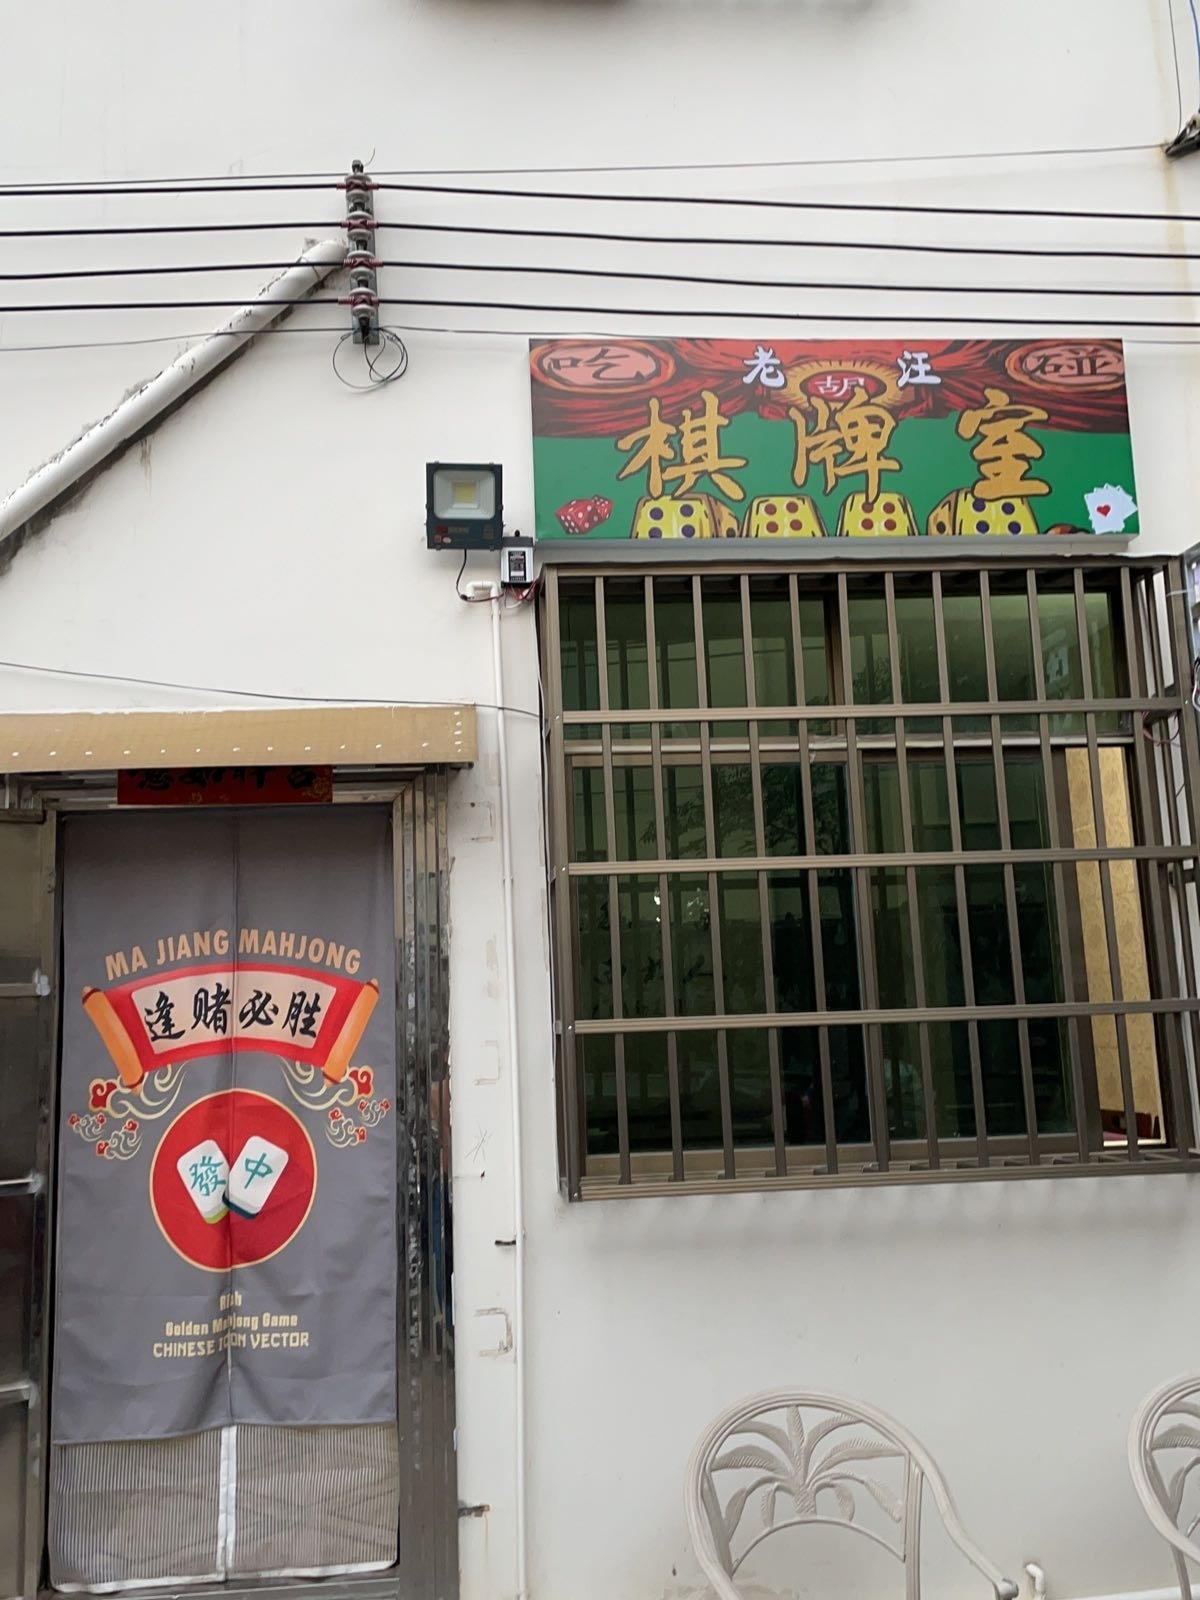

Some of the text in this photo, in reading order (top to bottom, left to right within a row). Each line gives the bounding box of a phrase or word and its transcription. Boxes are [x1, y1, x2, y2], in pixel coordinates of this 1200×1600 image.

[549, 347, 645, 382] 吃
[615, 388, 1052, 504] 棋牌室
[104, 928, 361, 981] MA JIANG MAHJONG
[144, 982, 322, 1042] 逢赌必胜
[188, 1155, 227, 1197] 發
[244, 1152, 274, 1190] 中
[165, 1321, 209, 1337] Golden
[262, 1312, 298, 1328] Game
[153, 1339, 216, 1358] CHINESE
[250, 1332, 309, 1350] VECTOR
